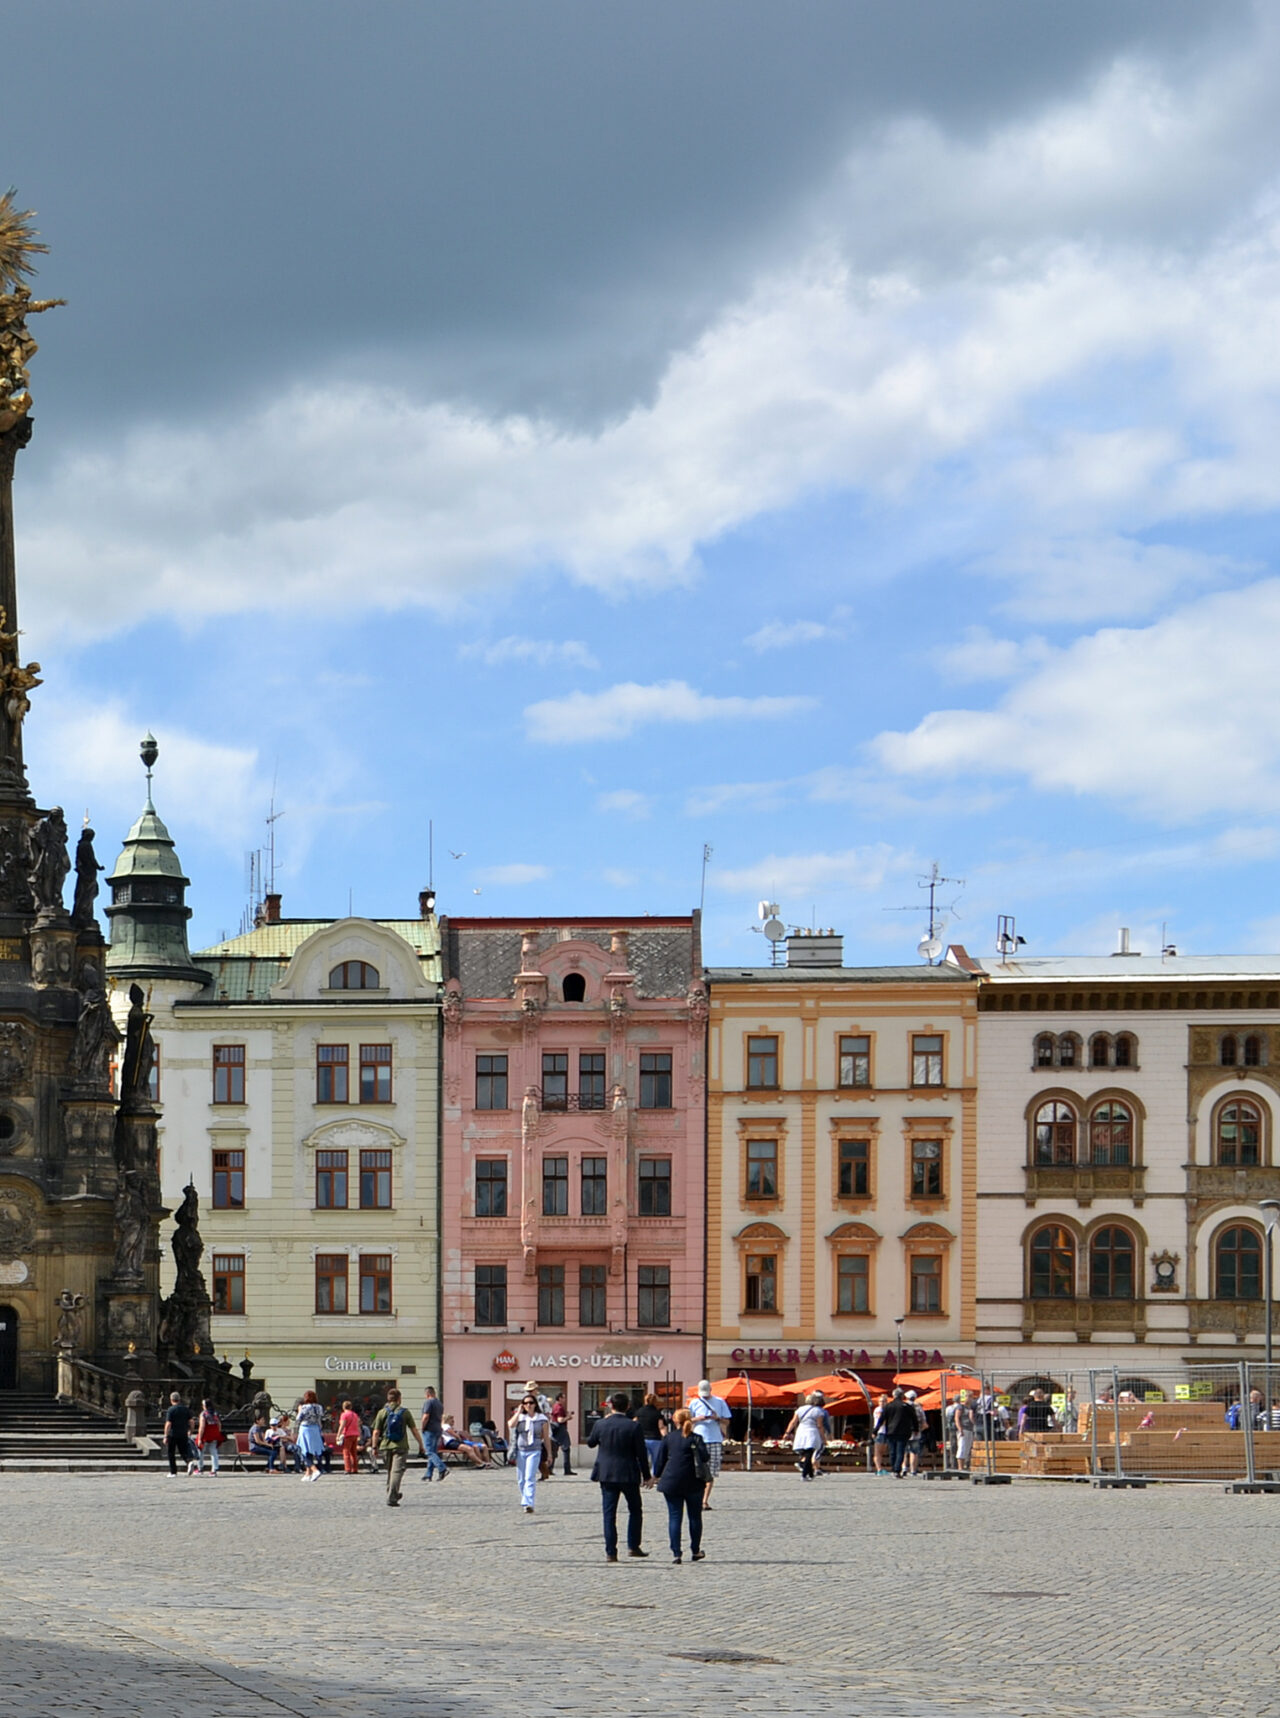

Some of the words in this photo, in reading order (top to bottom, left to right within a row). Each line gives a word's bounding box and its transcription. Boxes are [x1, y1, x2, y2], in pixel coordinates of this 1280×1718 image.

[496, 1356, 515, 1364] HAM
[731, 1345, 871, 1364] CUKRÁRNA
[883, 1349, 945, 1364] AIDA
[530, 1355, 581, 1367] MASO
